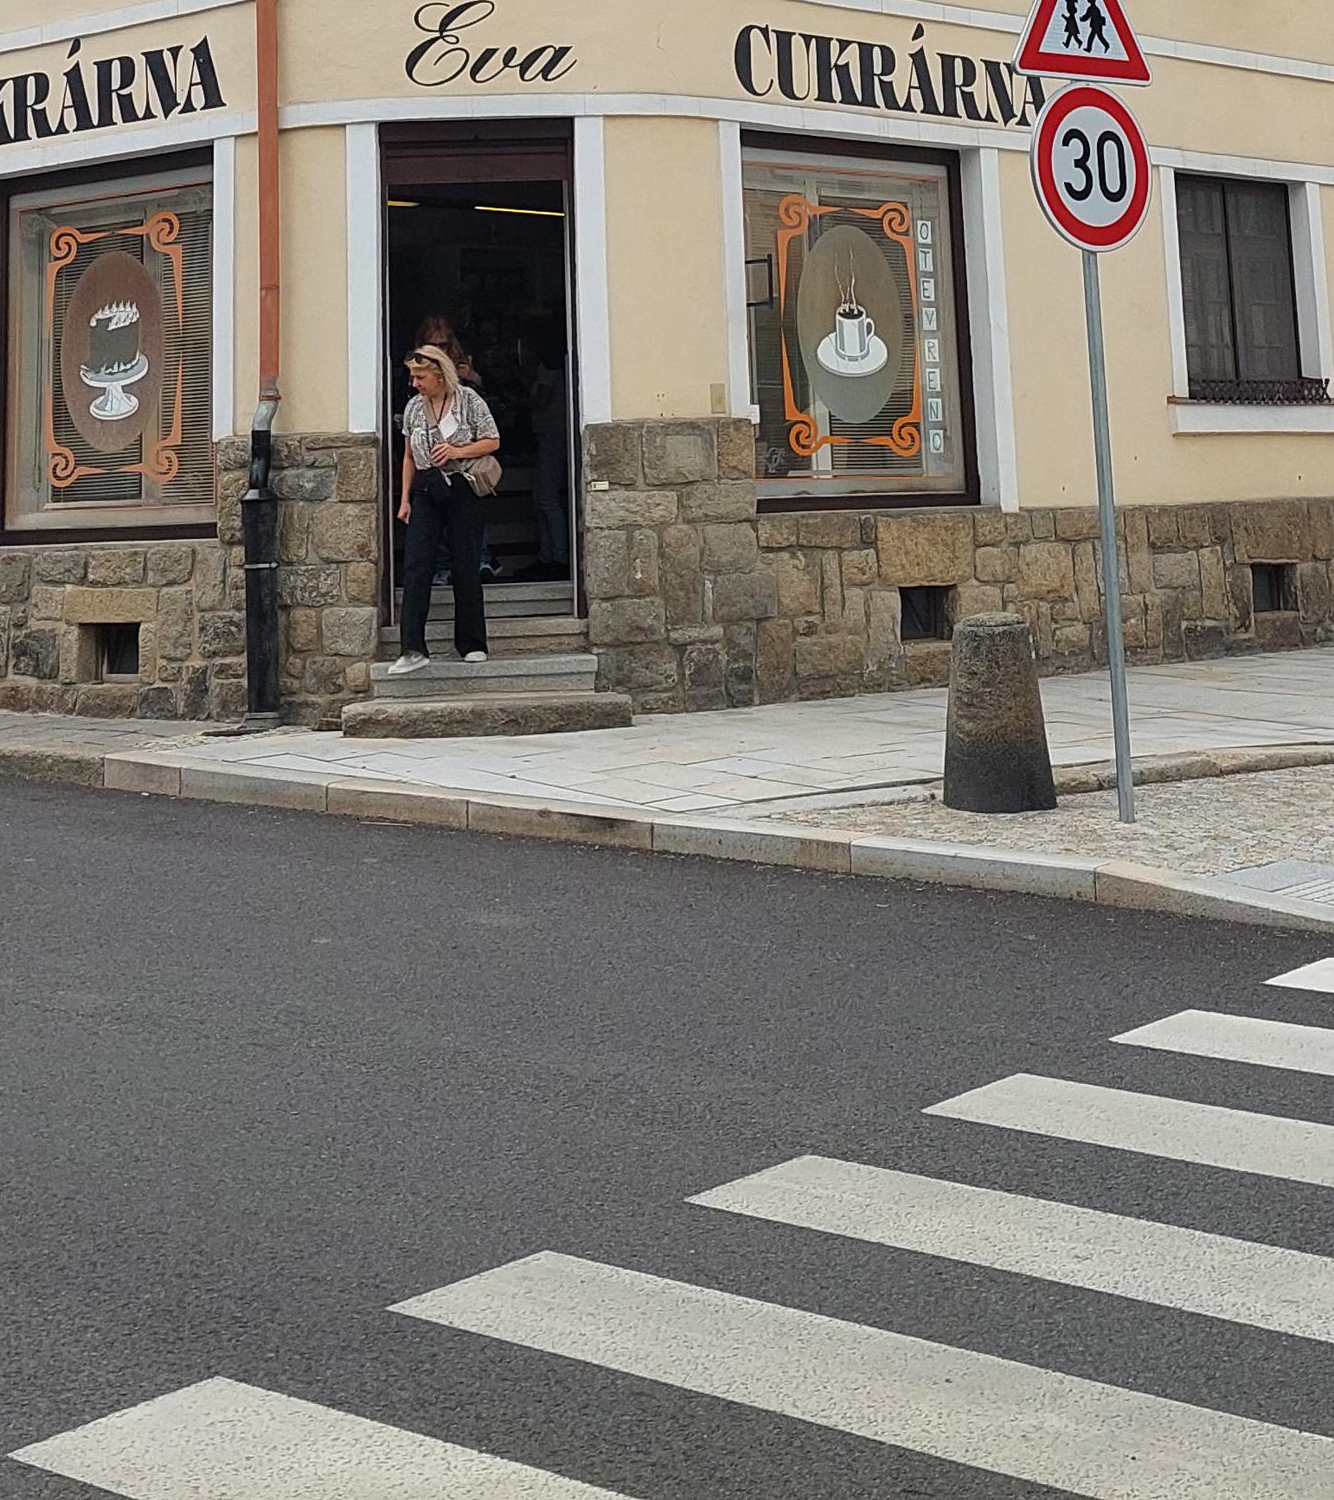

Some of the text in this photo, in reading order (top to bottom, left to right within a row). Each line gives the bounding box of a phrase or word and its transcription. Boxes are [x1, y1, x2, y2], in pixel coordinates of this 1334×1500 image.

[405, 0, 577, 87] Eva
[734, 23, 1046, 127] CUKRÁRNA
[1062, 128, 1127, 203] 30
